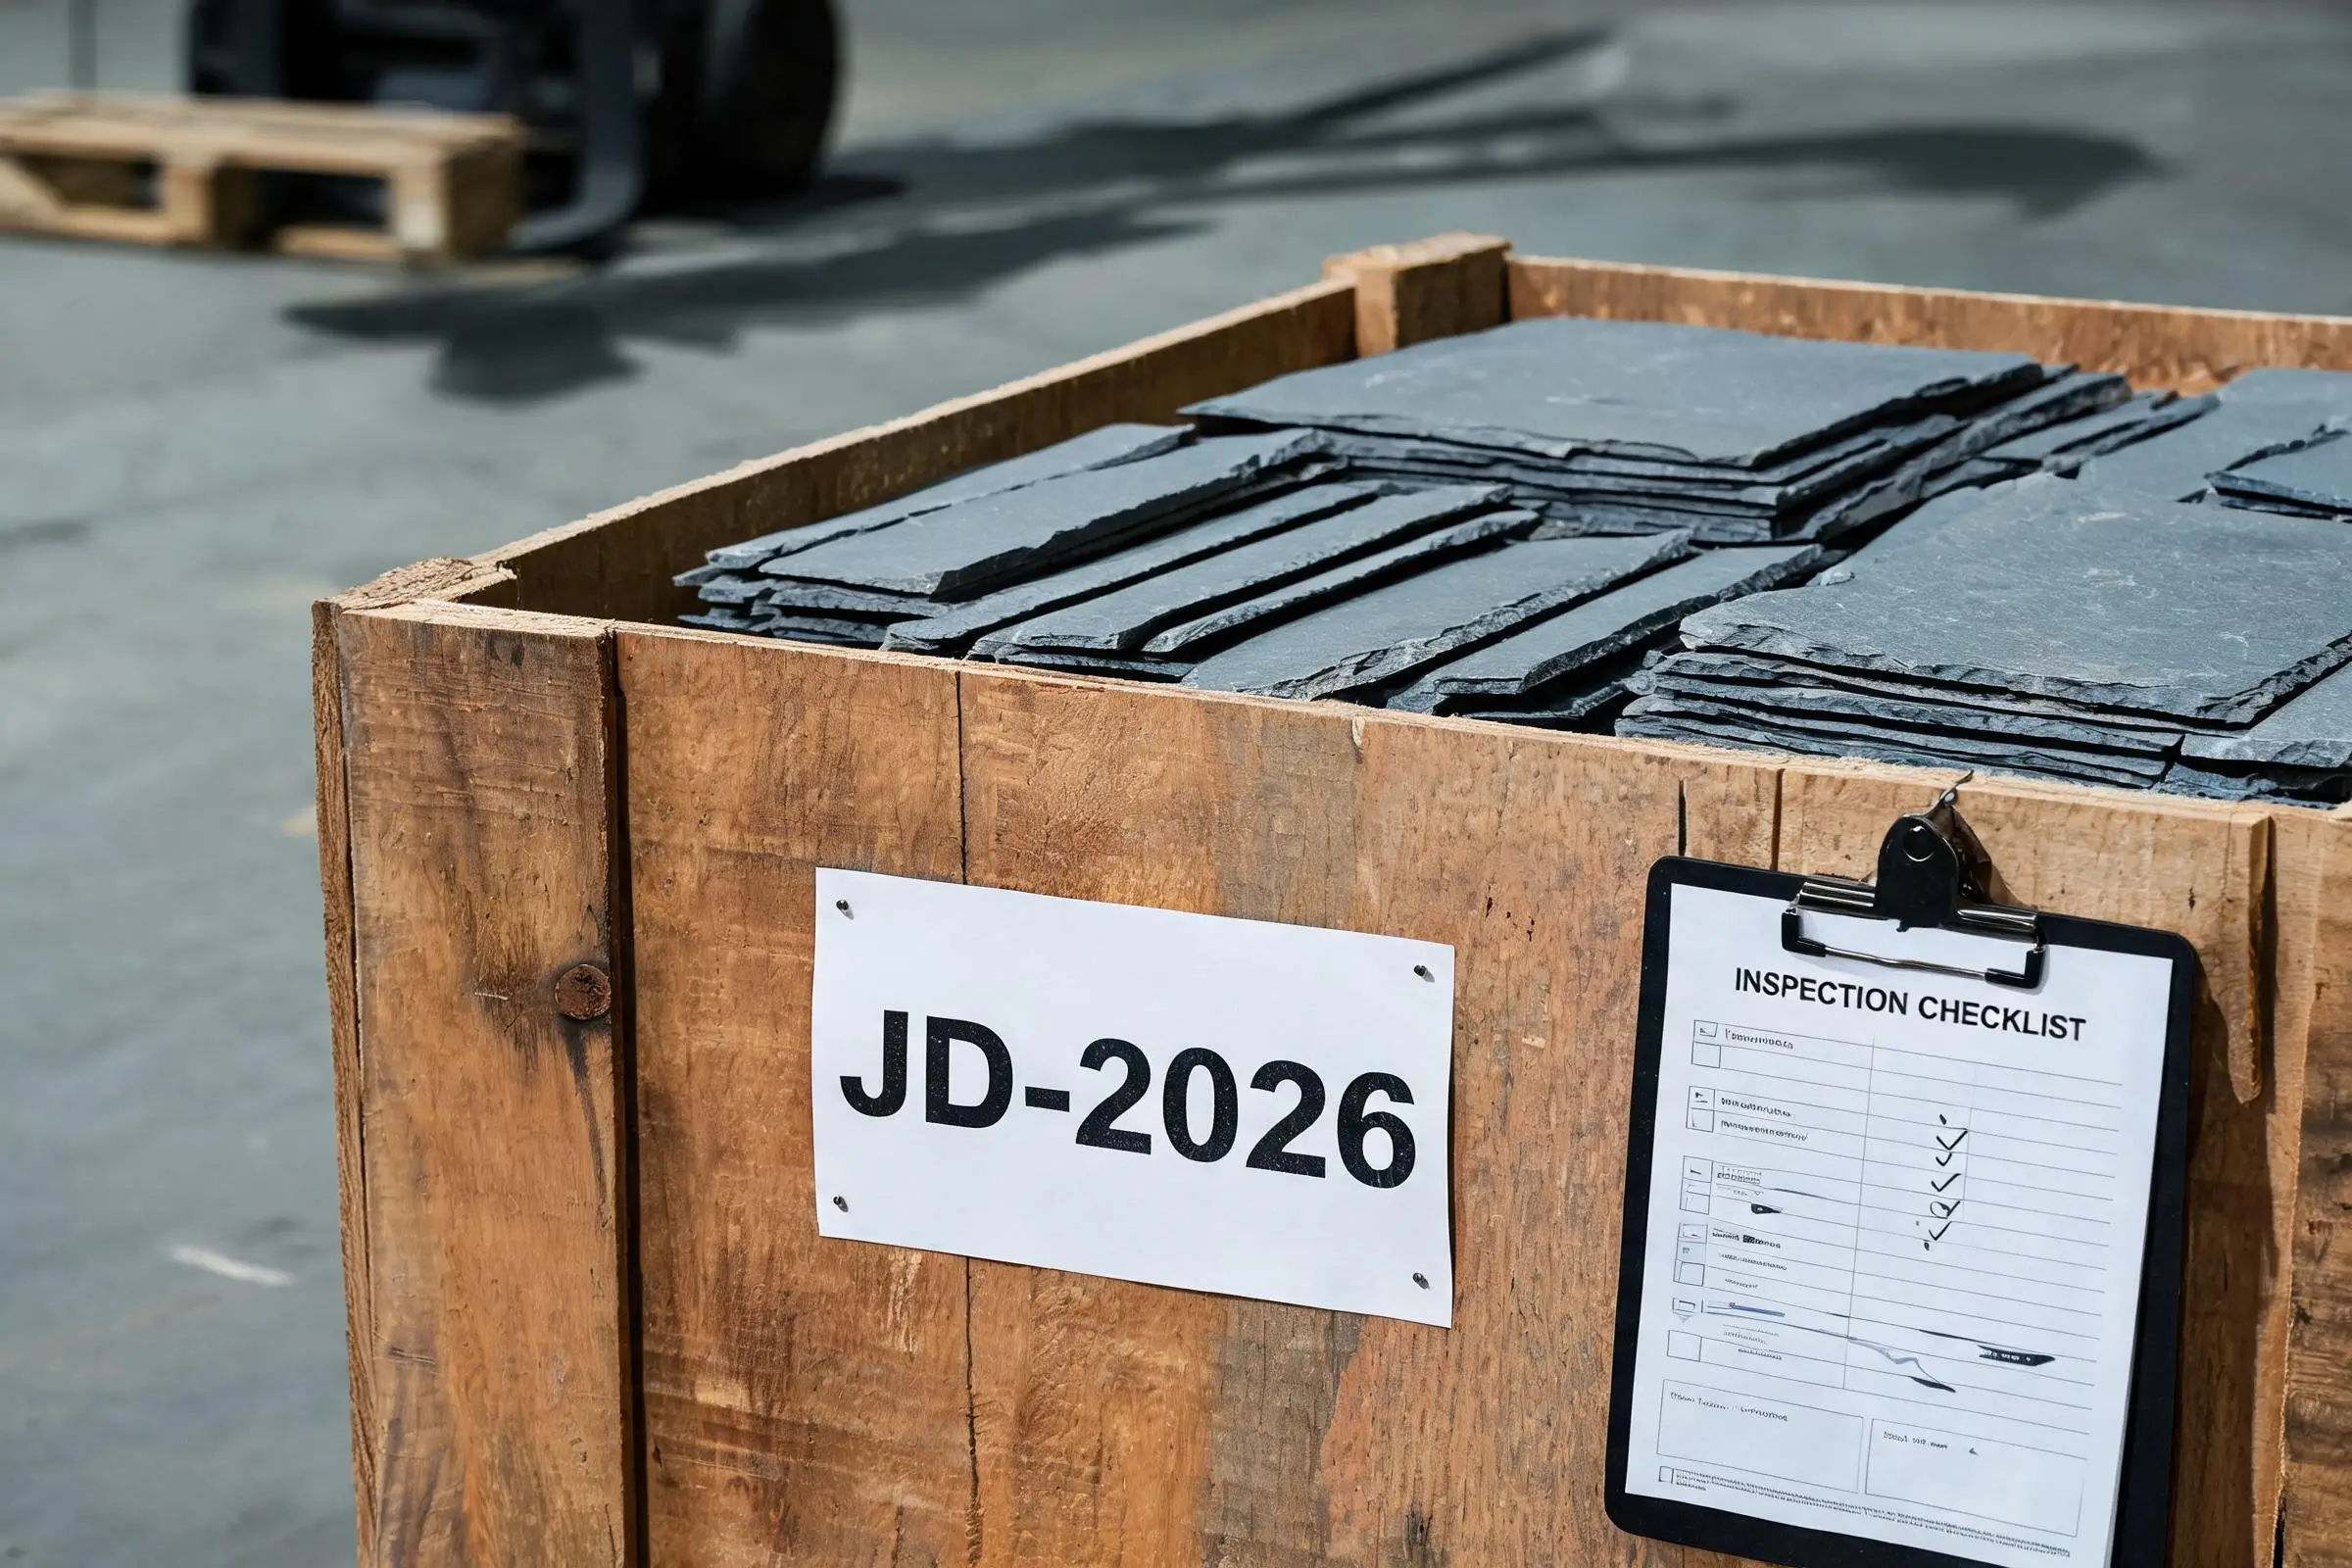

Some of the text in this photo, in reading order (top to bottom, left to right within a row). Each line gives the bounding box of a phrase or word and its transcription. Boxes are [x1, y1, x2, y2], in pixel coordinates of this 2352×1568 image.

[1735, 967, 2086, 1042] INSPECTION CHECKLIST
[839, 1009, 1416, 1189] JD-2026
